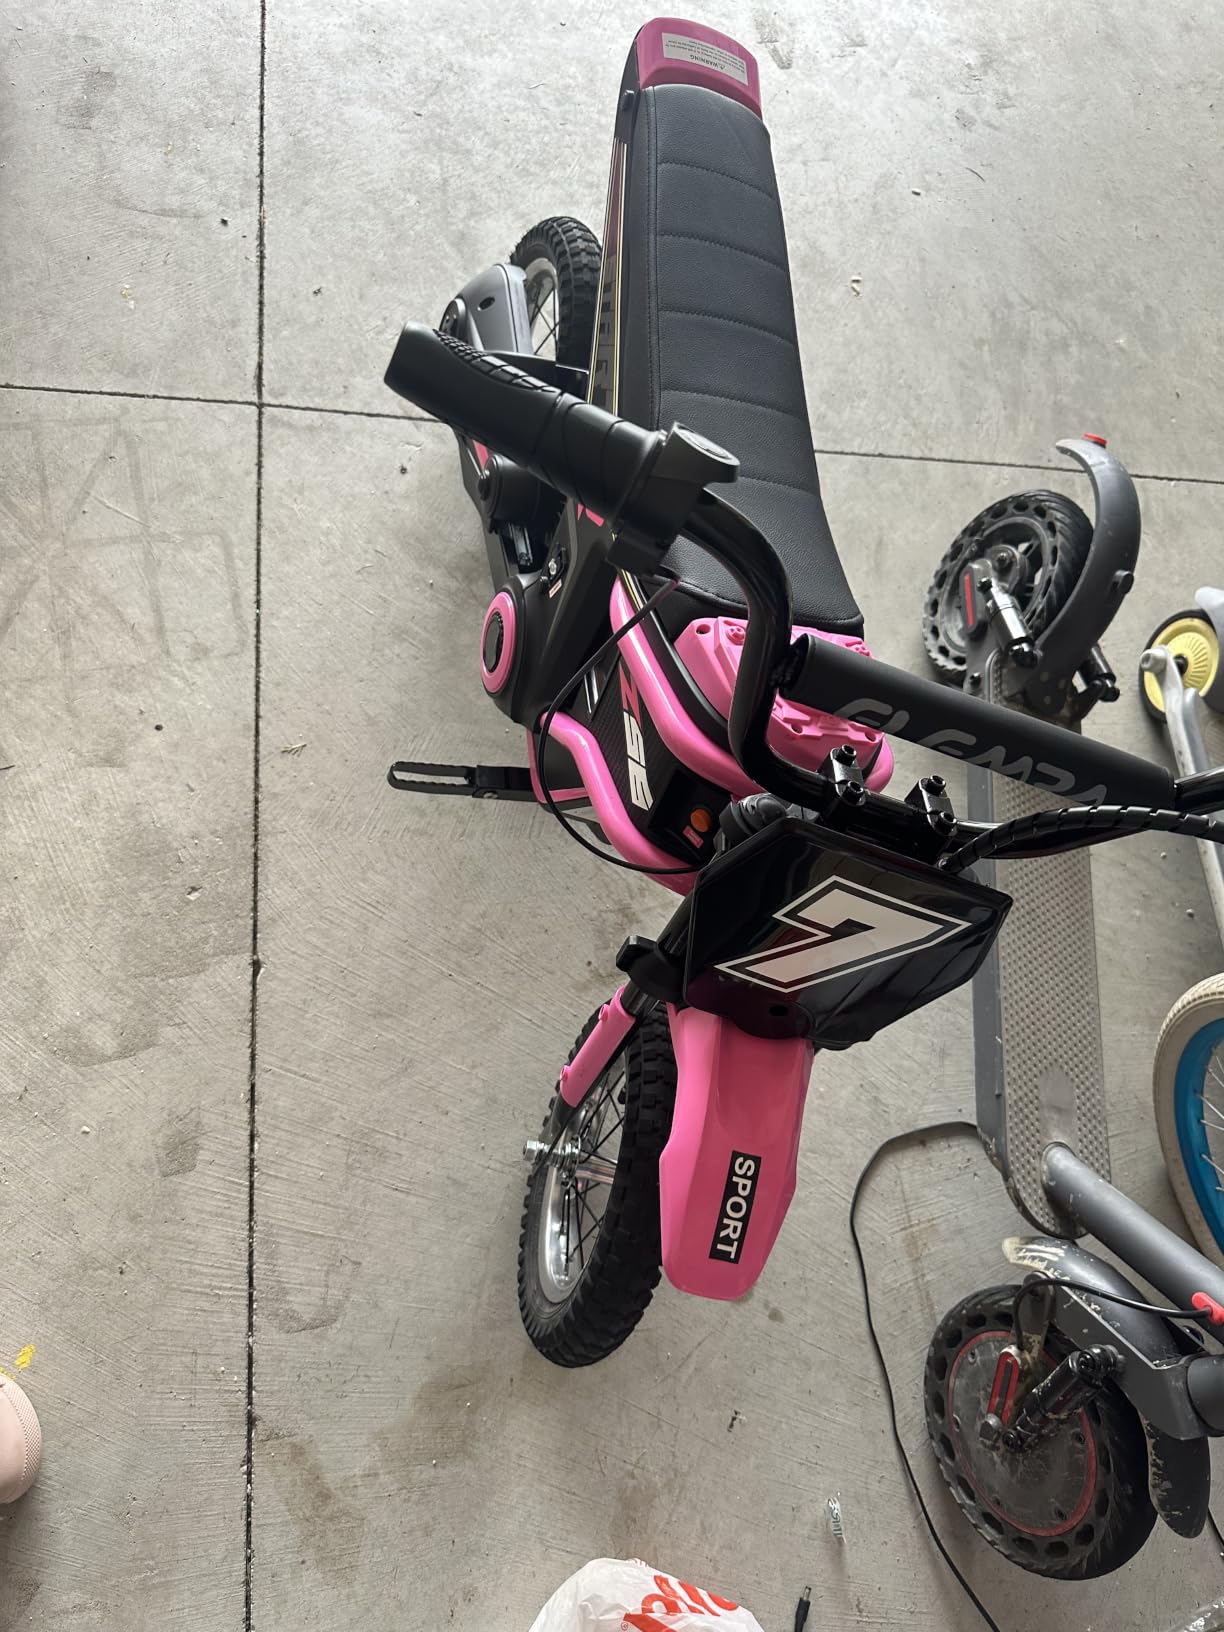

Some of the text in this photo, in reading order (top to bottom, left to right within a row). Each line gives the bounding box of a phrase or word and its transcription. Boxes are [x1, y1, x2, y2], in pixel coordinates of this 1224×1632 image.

[690, 54, 719, 68] WARNING
[713, 874, 973, 993] 7
[716, 1156, 756, 1260] SPORT
